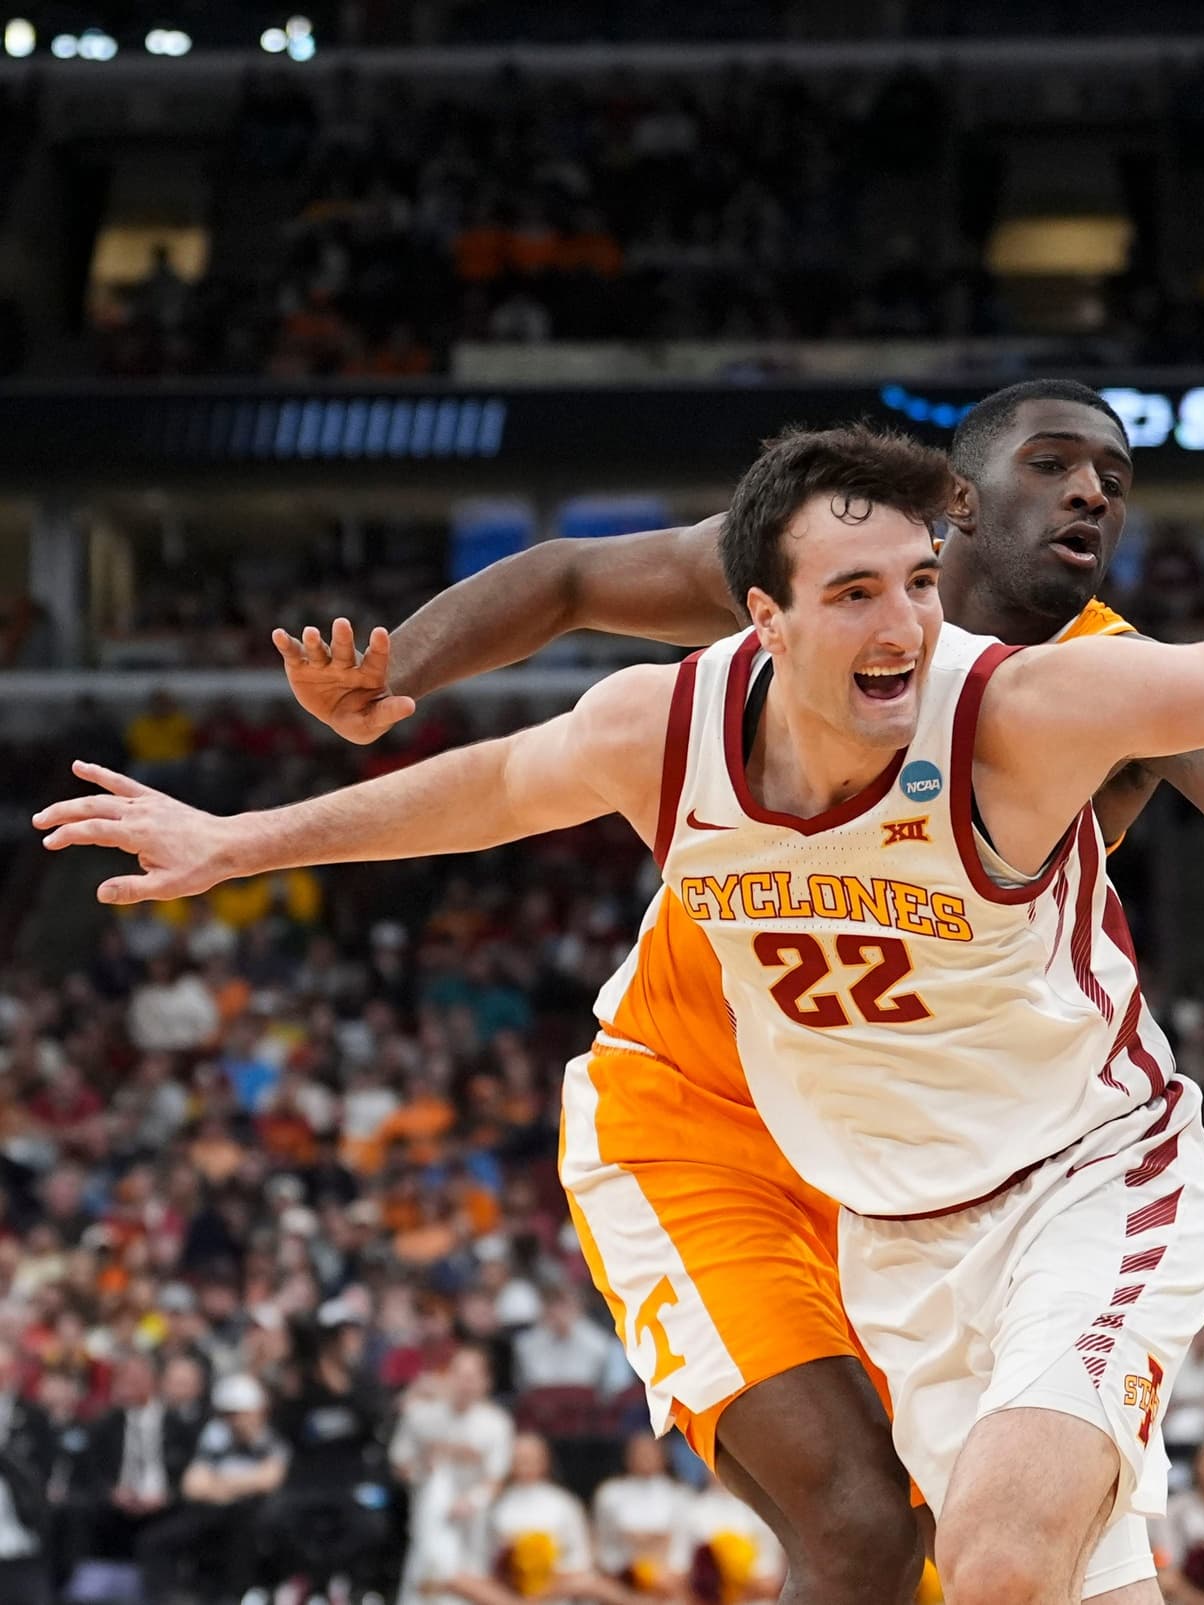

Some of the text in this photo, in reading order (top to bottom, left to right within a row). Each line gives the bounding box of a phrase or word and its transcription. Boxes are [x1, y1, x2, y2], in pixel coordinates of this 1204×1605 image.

[906, 778, 941, 794] NCAA
[681, 871, 974, 942] CYCLONES
[752, 931, 936, 1028] 22
